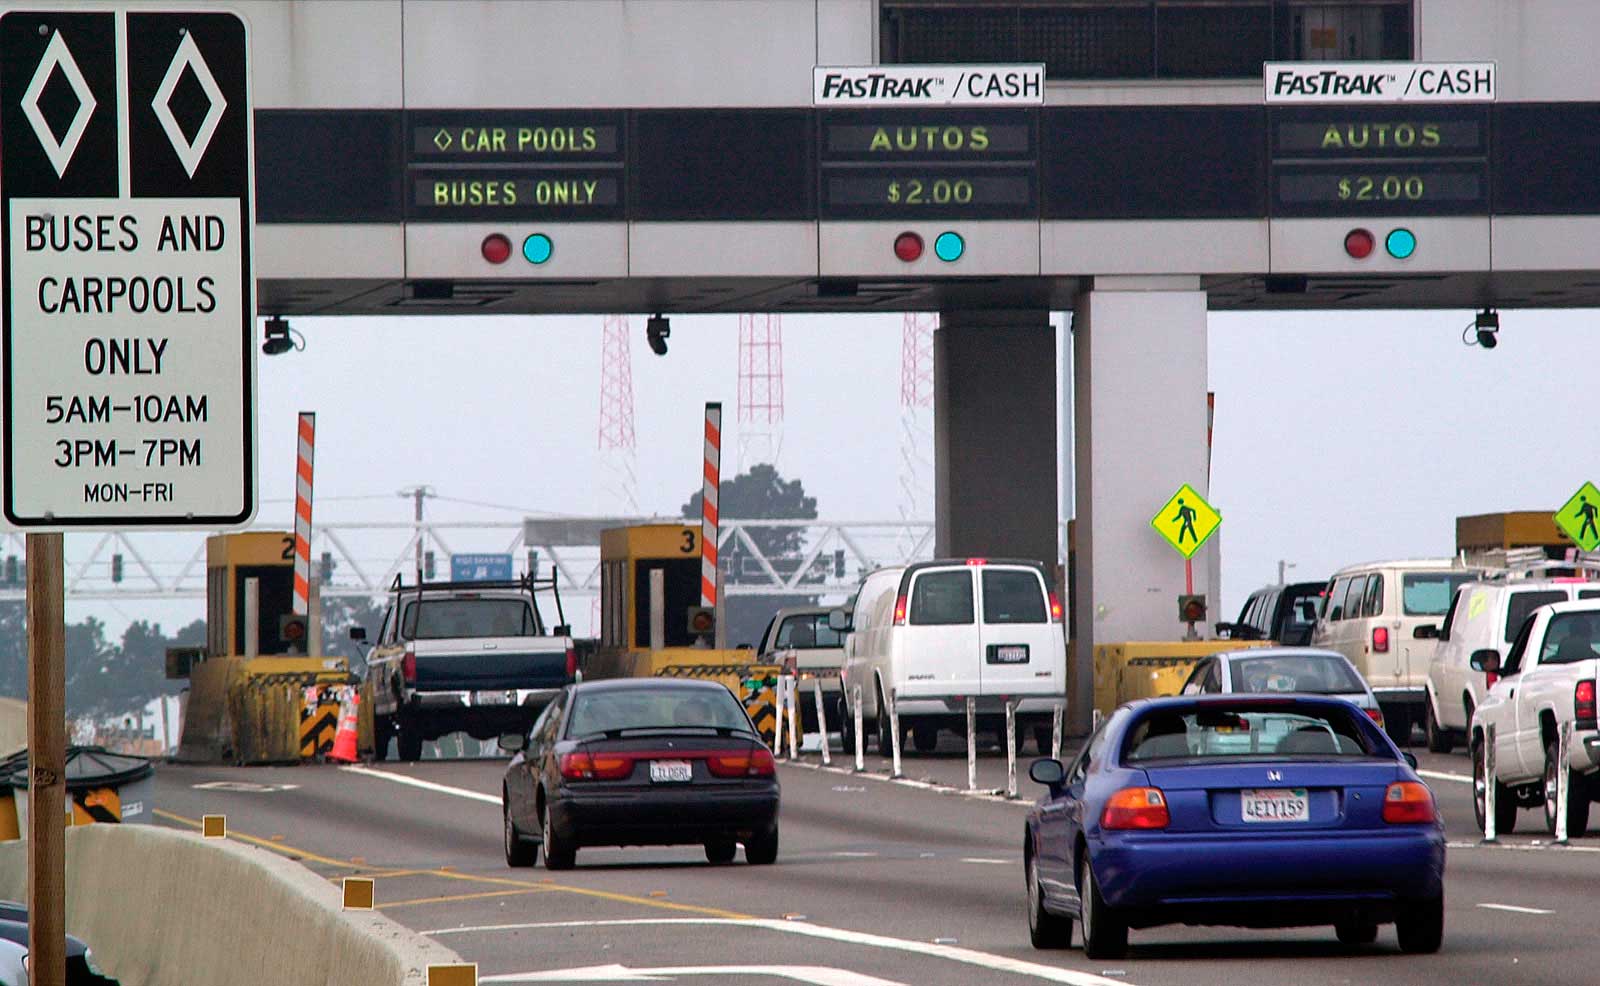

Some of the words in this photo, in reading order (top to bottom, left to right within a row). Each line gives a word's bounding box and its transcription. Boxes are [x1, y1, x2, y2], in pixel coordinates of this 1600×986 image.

[952, 72, 1039, 98] /CASH
[1404, 69, 1491, 95] /CASH
[461, 128, 506, 151] CAR
[517, 127, 596, 151] POOLS
[870, 126, 989, 150] AUTOS
[1322, 124, 1440, 147] AUTOS
[434, 182, 517, 205] BUSES
[535, 181, 597, 204] ONLY
[887, 179, 973, 204] $2.00
[1338, 176, 1424, 200] $2.00
[25, 215, 139, 252] BUSES
[157, 215, 225, 252] AND
[38, 276, 216, 314] CARPOOLS
[84, 337, 168, 375] ONLY
[46, 395, 208, 424] 5AM-10AM
[84, 483, 173, 503] MON-FRI
[282, 537, 296, 560] 2
[680, 529, 695, 553] 3
